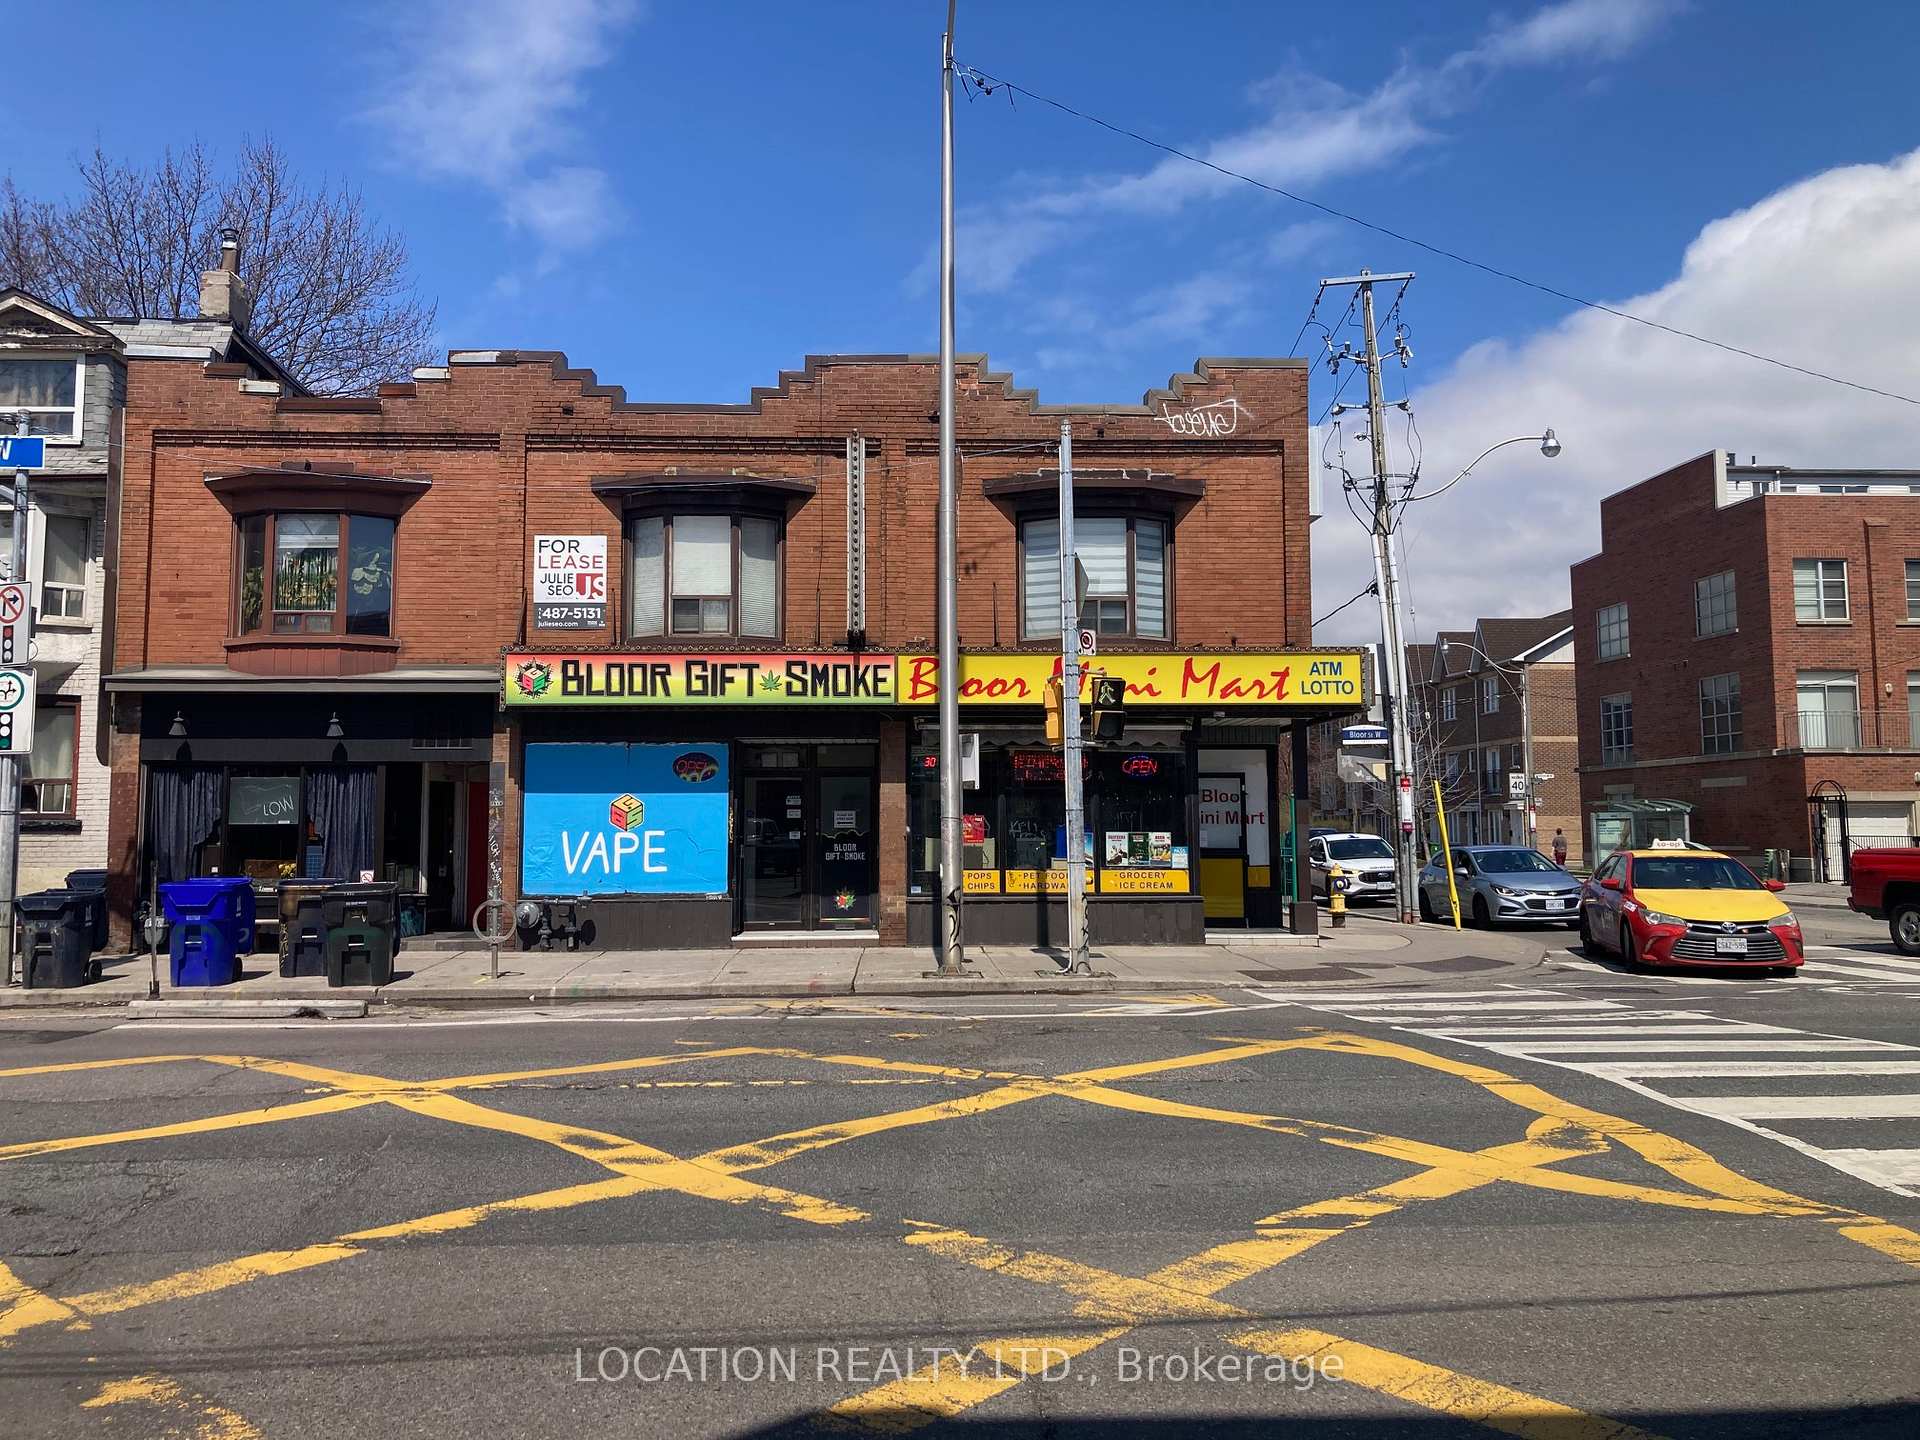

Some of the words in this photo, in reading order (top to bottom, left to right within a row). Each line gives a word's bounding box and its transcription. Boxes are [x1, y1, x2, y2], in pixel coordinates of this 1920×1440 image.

[538, 540, 580, 553] FOR
[538, 555, 604, 569] LEASE
[540, 573, 574, 584] JULIE
[547, 585, 574, 596] SEO
[542, 607, 601, 619] 487-5131
[1309, 661, 1343, 677] ATM
[561, 659, 672, 698] BLOOR
[685, 659, 760, 698] GIFT
[785, 660, 892, 698] SMOKE
[908, 657, 1032, 700] Boor
[1181, 656, 1291, 700] Mart
[1300, 680, 1354, 696] LOTTO
[924, 757, 937, 768] 30
[1512, 781, 1524, 791] 40
[263, 795, 294, 816] LOW
[561, 830, 668, 874] VAPE
[834, 844, 857, 852] BLOOR
[967, 872, 992, 880] POPS
[1023, 872, 1042, 880] PET
[1119, 871, 1167, 879] GROCERY
[967, 882, 995, 890] CHIPS
[1119, 881, 1136, 889] ICE
[1139, 881, 1174, 889] CREAM
